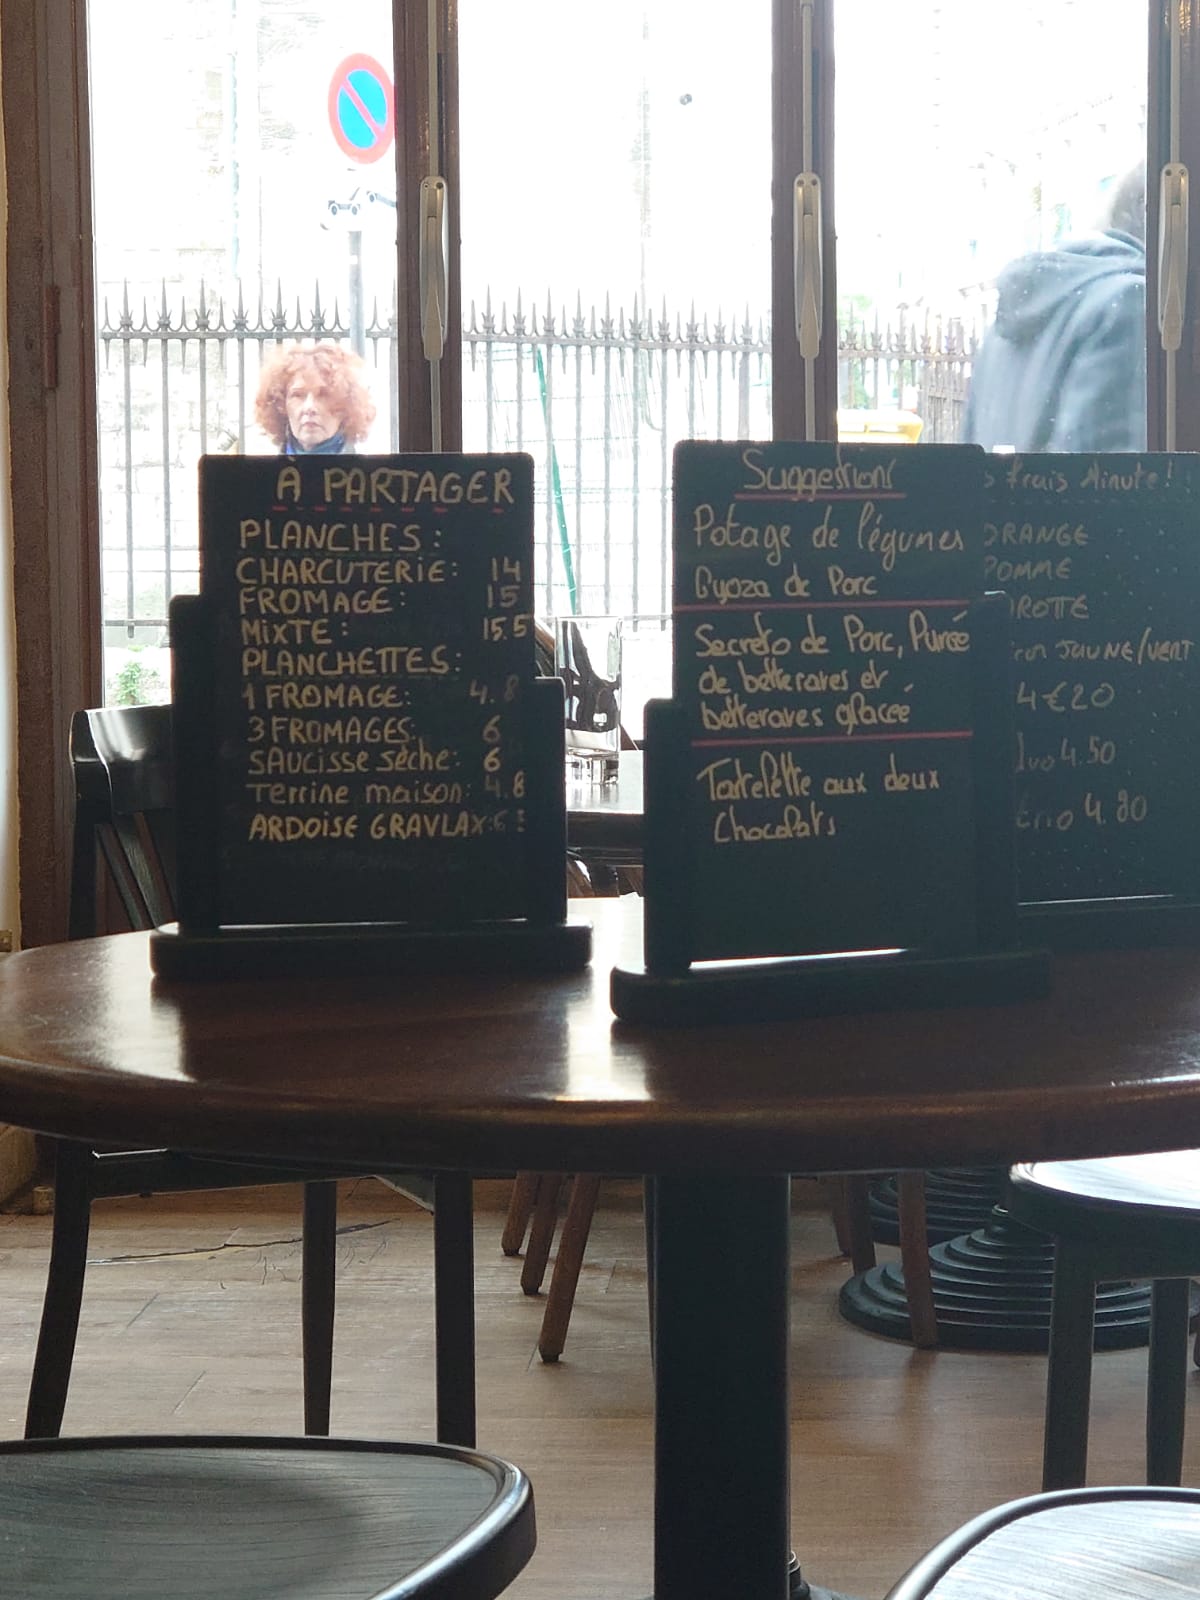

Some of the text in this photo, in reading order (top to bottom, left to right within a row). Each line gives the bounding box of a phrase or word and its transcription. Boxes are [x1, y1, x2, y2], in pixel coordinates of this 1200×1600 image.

[276, 457, 514, 504] À PARTAGER
[694, 501, 964, 571] Potage de légumes
[490, 556, 520, 582] 14
[695, 563, 879, 605] Gyoza de Porc
[487, 585, 519, 608] 15
[800, 614, 830, 654] de
[844, 614, 903, 659] Porc,
[909, 609, 970, 652] Purée
[699, 658, 889, 694] de betteraves et
[241, 683, 254, 710] 1
[702, 693, 823, 730] betteraves
[248, 716, 265, 743] 3
[482, 715, 501, 743] 6
[483, 747, 501, 772] 6
[696, 750, 940, 801] Tartelette aux deux
